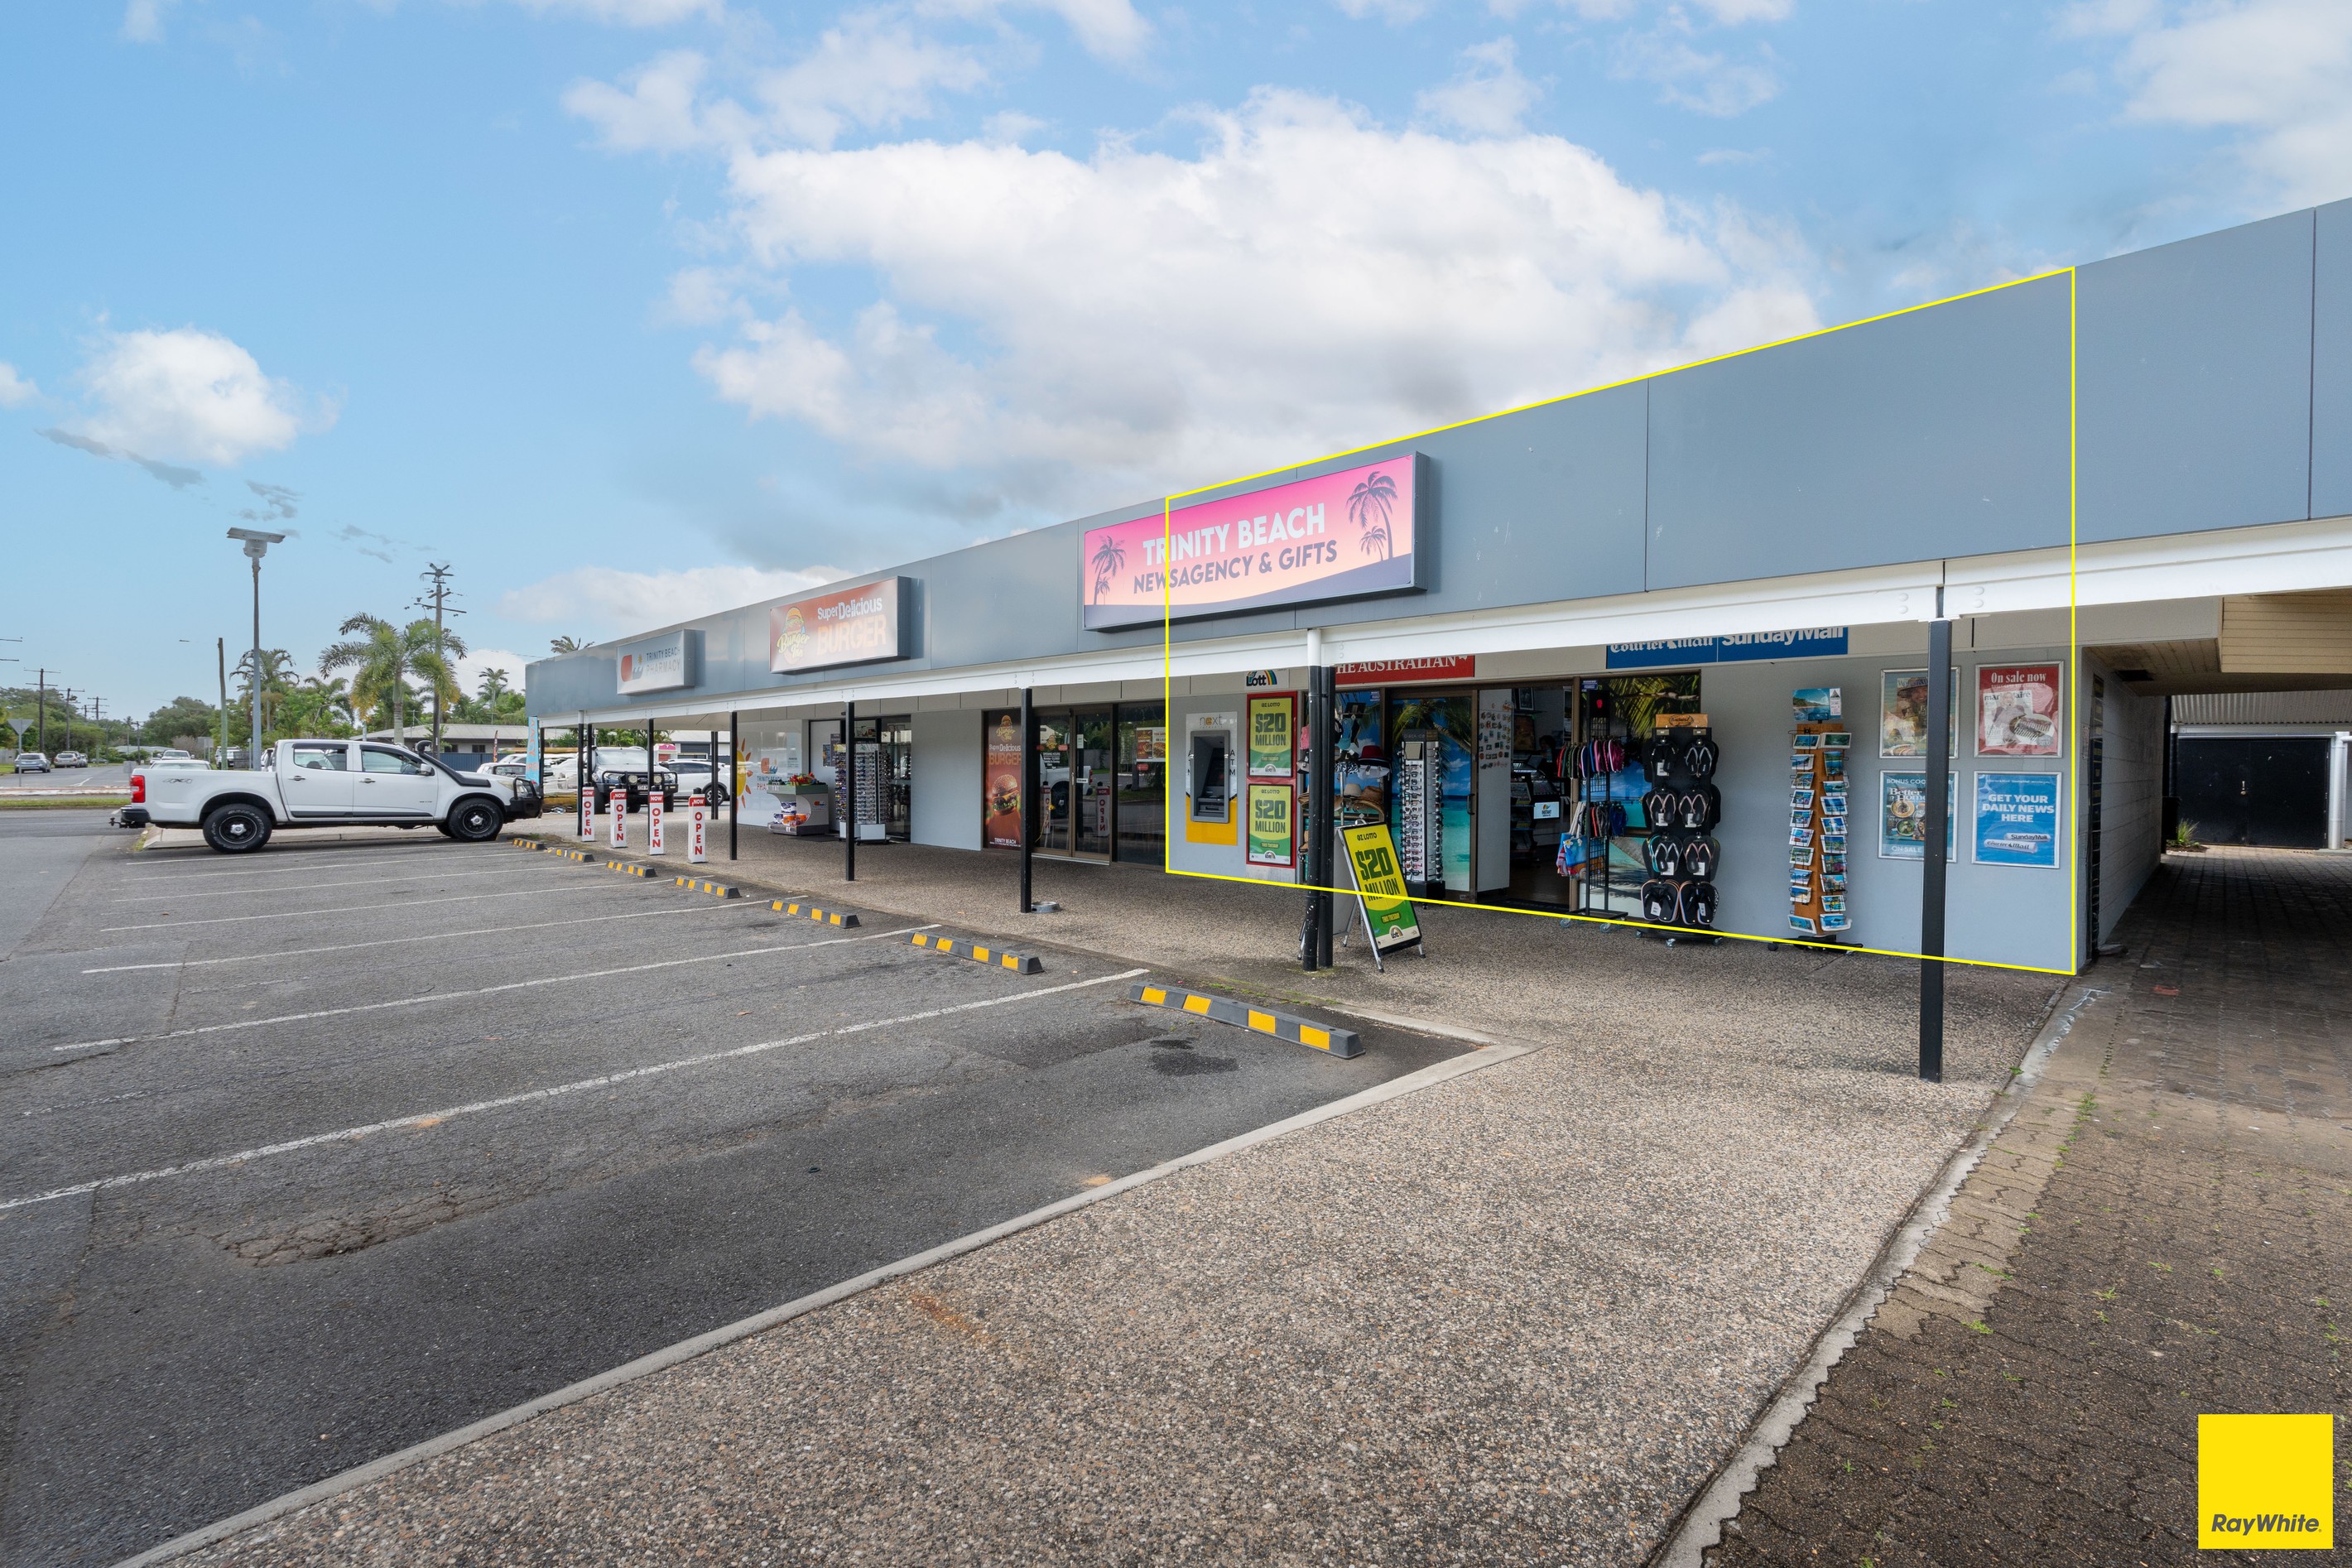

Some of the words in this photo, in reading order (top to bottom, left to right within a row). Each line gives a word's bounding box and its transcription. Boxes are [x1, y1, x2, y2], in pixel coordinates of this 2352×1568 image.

[1142, 523, 1230, 565] TRINITY
[1238, 503, 1325, 550] BEACH
[1133, 556, 1253, 594] NEWSAGENCY
[1258, 551, 1272, 574] &
[1279, 540, 1338, 571] GIFTS
[817, 607, 838, 621] Super
[838, 597, 883, 620] Delicious
[777, 632, 810, 654] Burger
[816, 613, 887, 656] BURGER
[646, 649, 664, 662] TRINITY
[646, 658, 681, 676] PHARMACY
[1246, 675, 1267, 687] Lott
[1991, 672, 2004, 685] On
[2005, 671, 2025, 684] sale
[2027, 672, 2047, 683] now
[1199, 714, 1223, 726] next
[1255, 713, 1287, 733] $20
[1255, 733, 1287, 747] MILLION
[1888, 787, 1923, 796] Better
[1988, 794, 2012, 802] GET
[2013, 795, 2049, 804] YOUR
[584, 801, 592, 835] OPEN
[1255, 798, 1287, 820] $20
[1982, 803, 2016, 812] DAILY
[2018, 805, 2055, 814] NEWS
[616, 804, 624, 841] OPEN
[652, 807, 661, 848] OPEN
[1255, 820, 1287, 834] MILLION
[2001, 814, 2034, 823] HERE
[695, 811, 703, 855] OPEN
[1363, 832, 1378, 840] LOTTO
[1903, 845, 1923, 854] SALE
[1355, 846, 1394, 882] $20
[1364, 878, 1401, 902] MILLION
